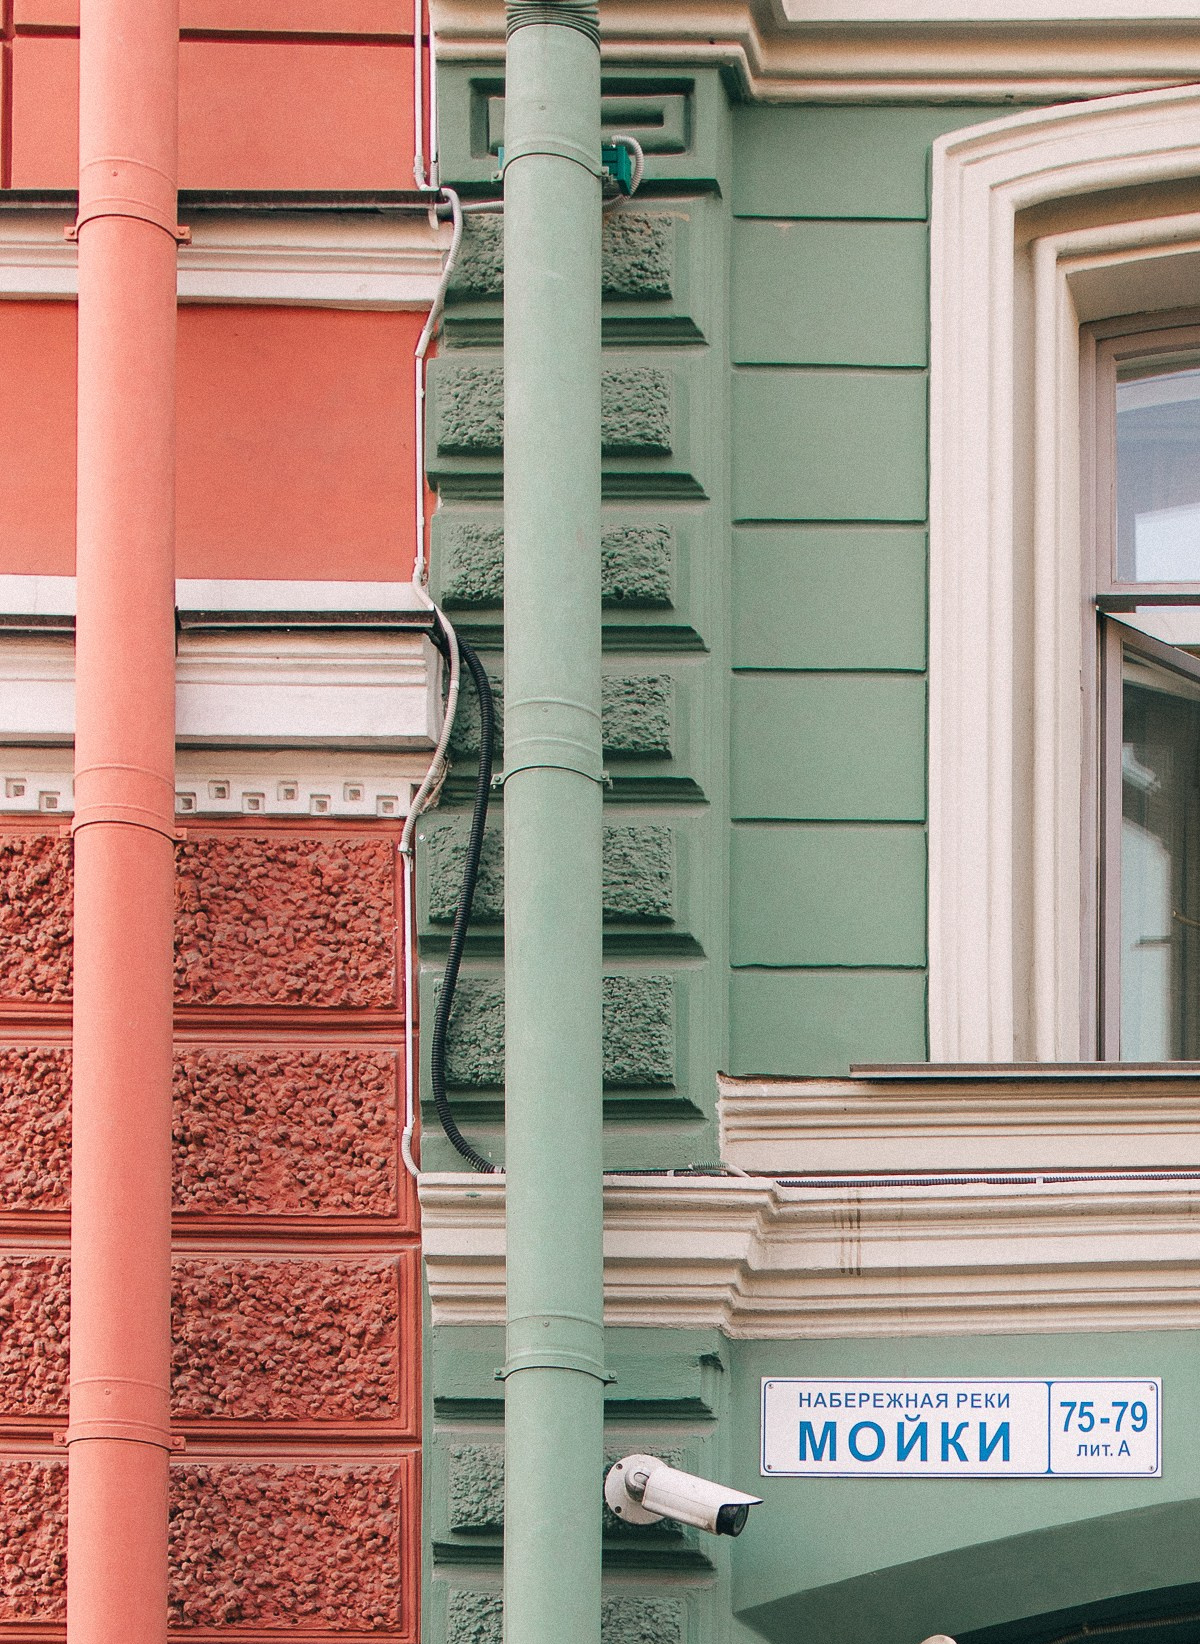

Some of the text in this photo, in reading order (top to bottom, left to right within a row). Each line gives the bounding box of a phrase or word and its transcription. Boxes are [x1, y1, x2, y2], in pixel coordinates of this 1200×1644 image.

[799, 1392, 1011, 1409] НАБЕРЕЖНАЯ РЕКИ
[1059, 1400, 1148, 1433] 75-79
[799, 1414, 1011, 1463] МОЙКИ
[1076, 1440, 1131, 1457] лит. А
